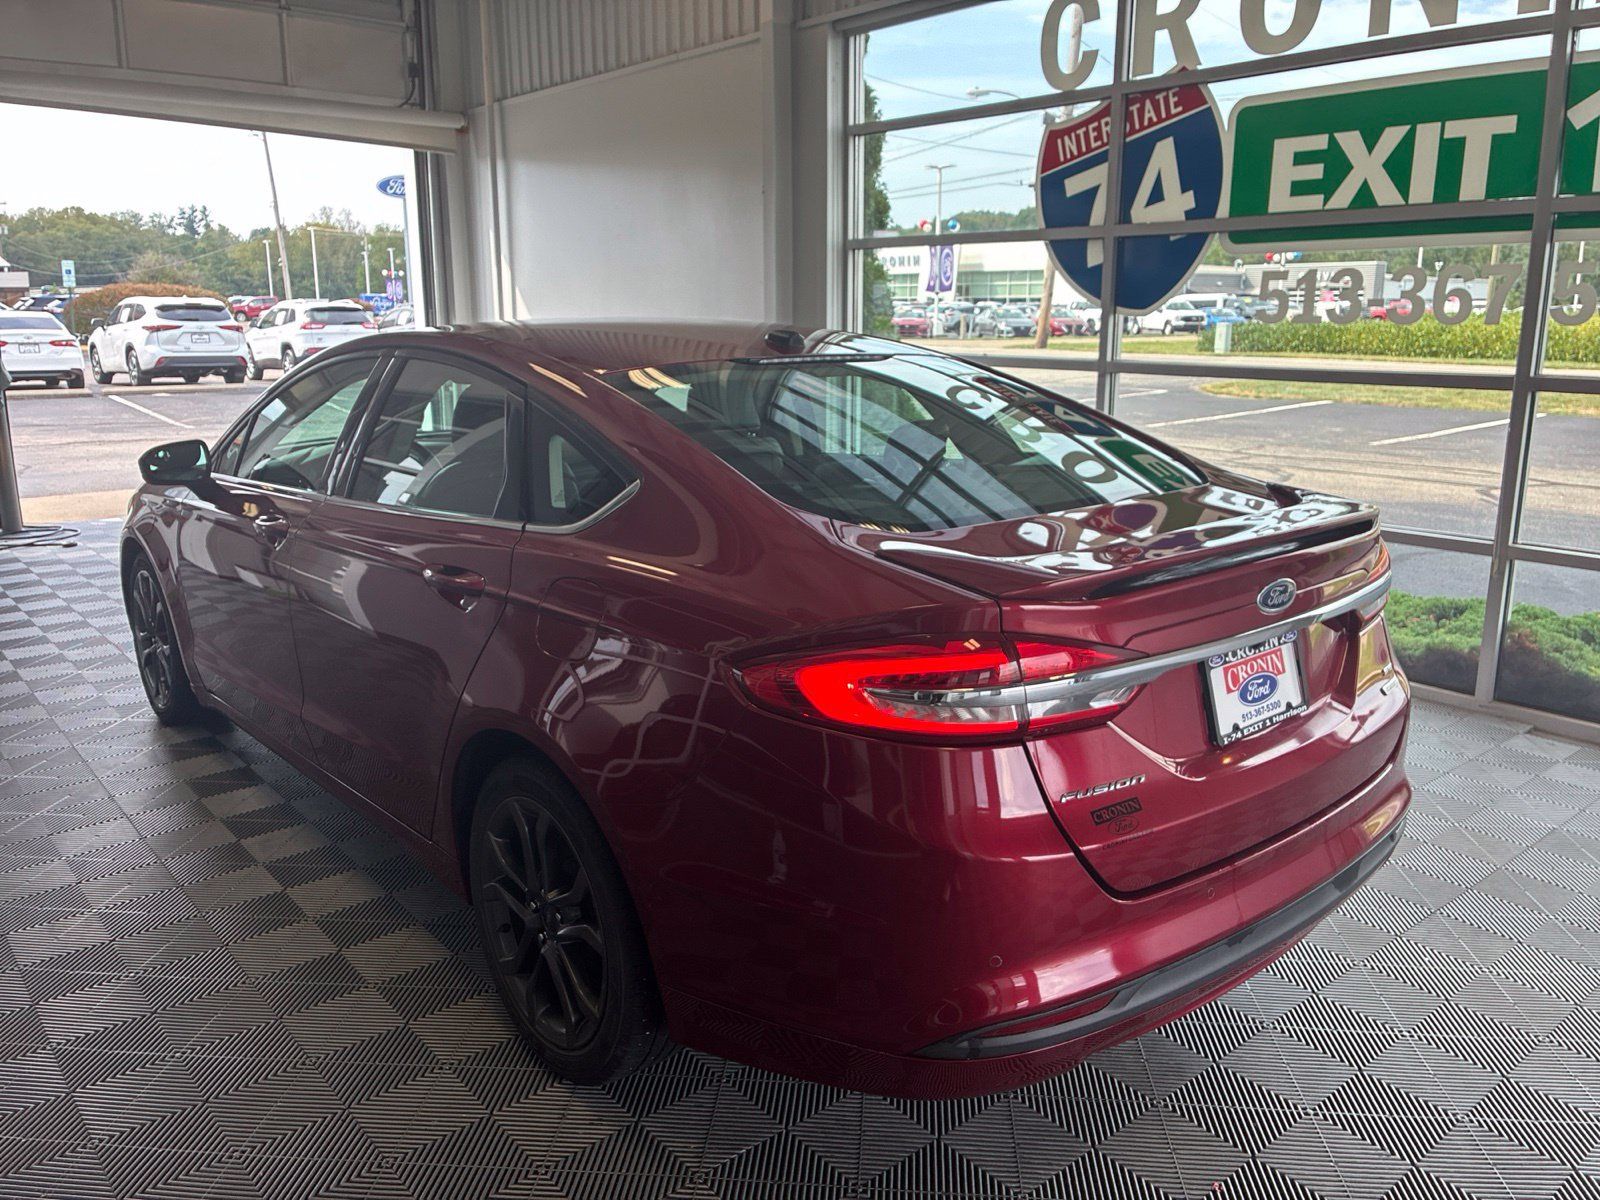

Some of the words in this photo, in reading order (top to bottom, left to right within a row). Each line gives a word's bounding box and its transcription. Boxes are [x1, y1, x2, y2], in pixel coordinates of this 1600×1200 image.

[1057, 88, 1184, 162] INTERTATE
[1268, 115, 1518, 213] EXIT
[1064, 136, 1196, 268] 74
[1267, 585, 1294, 606] Ford
[1227, 651, 1285, 691] CRONIN
[1247, 677, 1271, 700] Ford
[1223, 730, 1242, 745] I-74
[1243, 721, 1264, 735] EXIT
[1265, 717, 1272, 727] 1
[1272, 704, 1308, 723] Harrison
[1241, 700, 1282, 722] 513-367-5300
[1093, 798, 1141, 823] CRONIN
